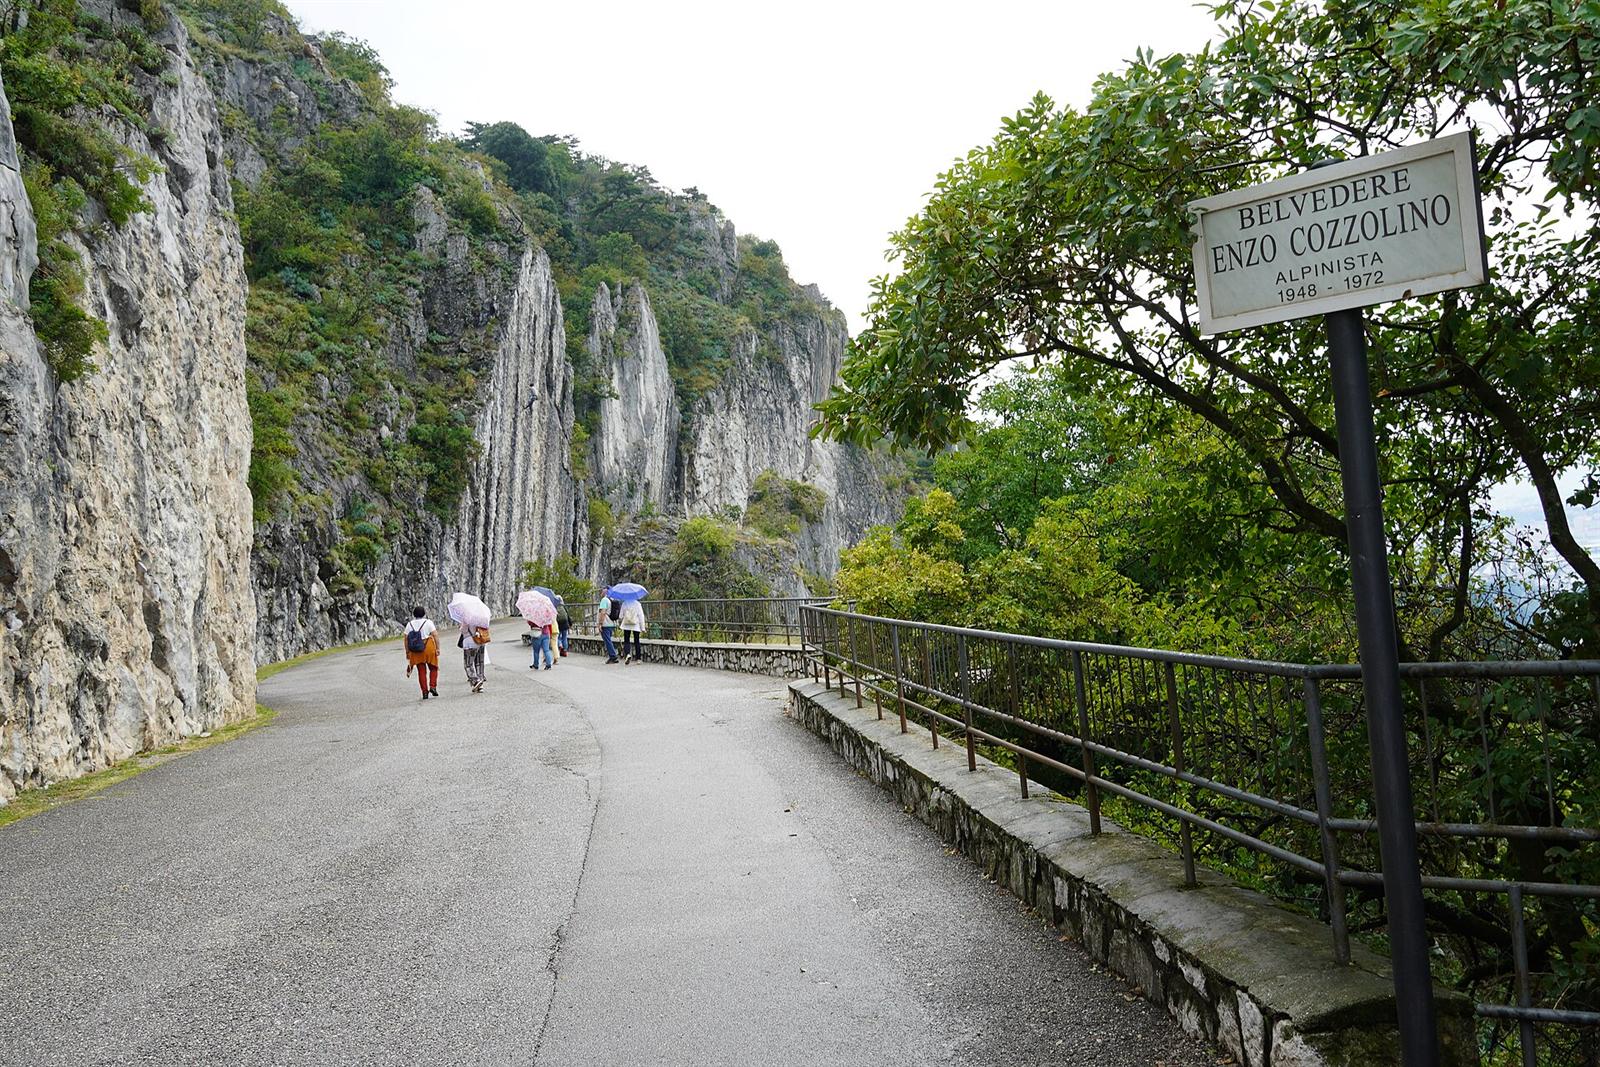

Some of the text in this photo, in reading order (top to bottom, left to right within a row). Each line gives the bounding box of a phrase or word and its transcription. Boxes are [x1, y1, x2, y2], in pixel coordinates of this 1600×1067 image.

[1239, 168, 1411, 230] BELVEDERE
[1211, 194, 1451, 274] ENZO COZZOLINO
[1275, 251, 1384, 285] ALPINISTA
[1278, 284, 1317, 303] 1948
[1344, 270, 1385, 290] 1972
